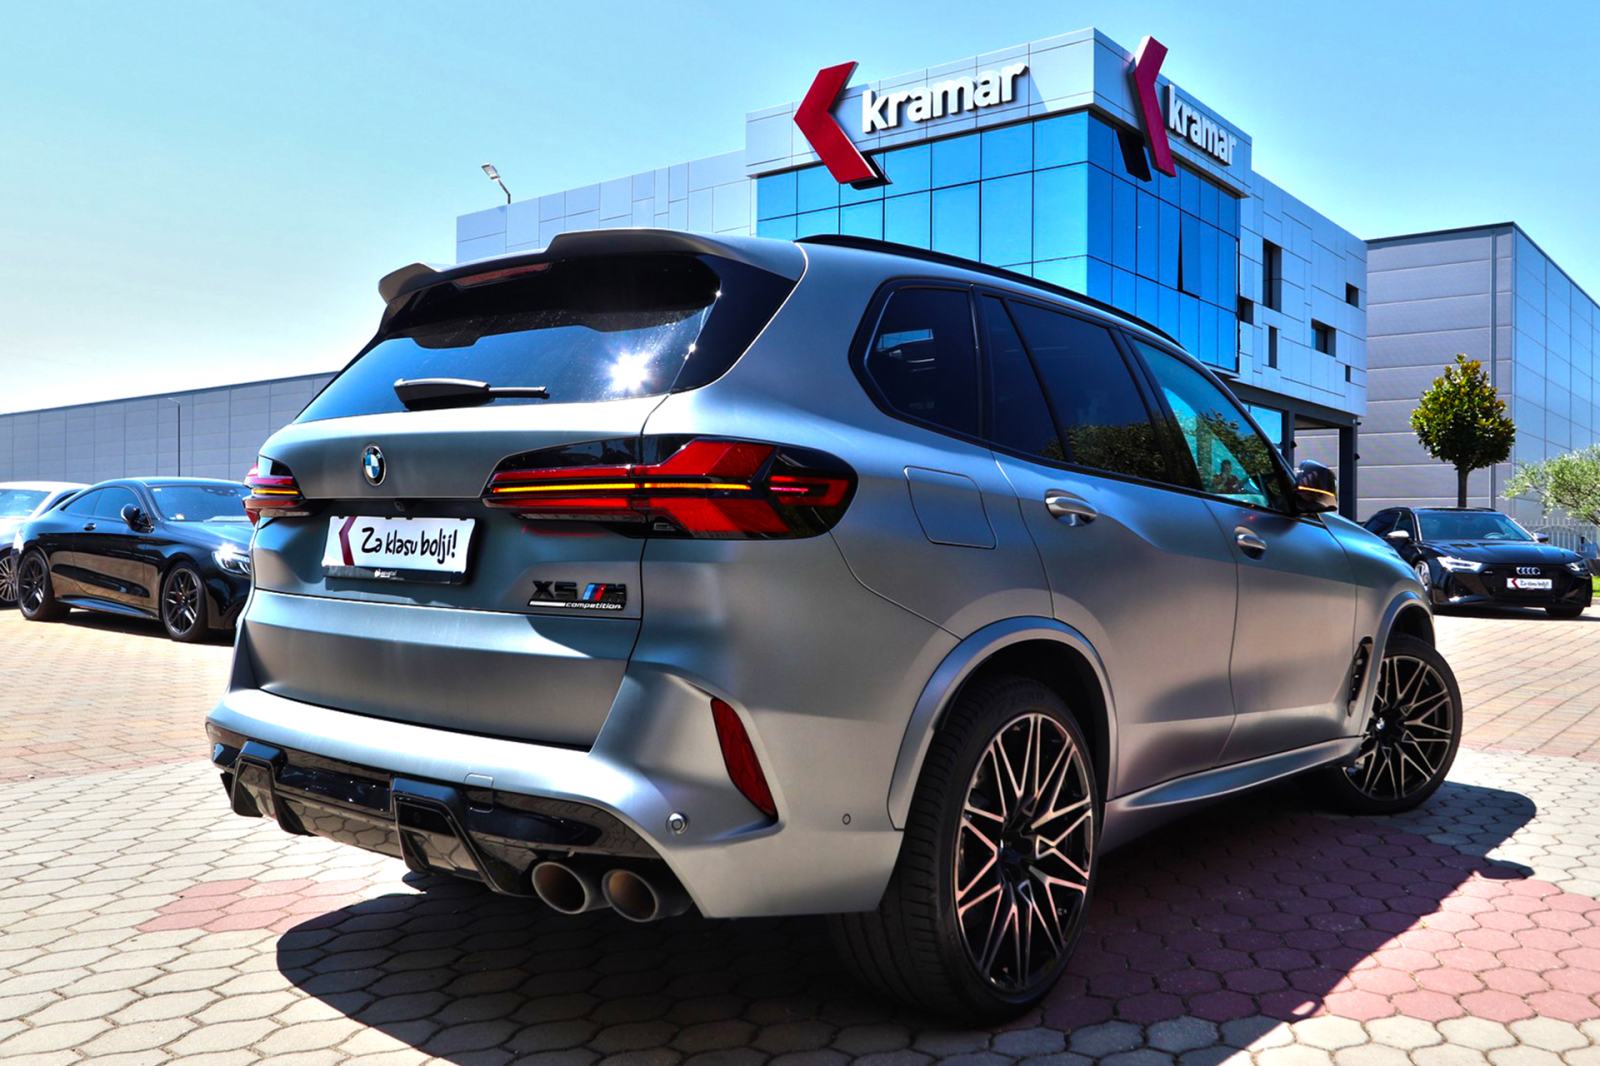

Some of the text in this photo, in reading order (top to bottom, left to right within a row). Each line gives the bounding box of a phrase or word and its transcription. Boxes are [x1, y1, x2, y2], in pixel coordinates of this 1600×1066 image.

[862, 62, 1026, 133] kramar
[1168, 83, 1237, 165] kramar
[361, 526, 458, 565] Za klasu bolji!
[531, 581, 577, 600] X5
[565, 601, 623, 610] competition
